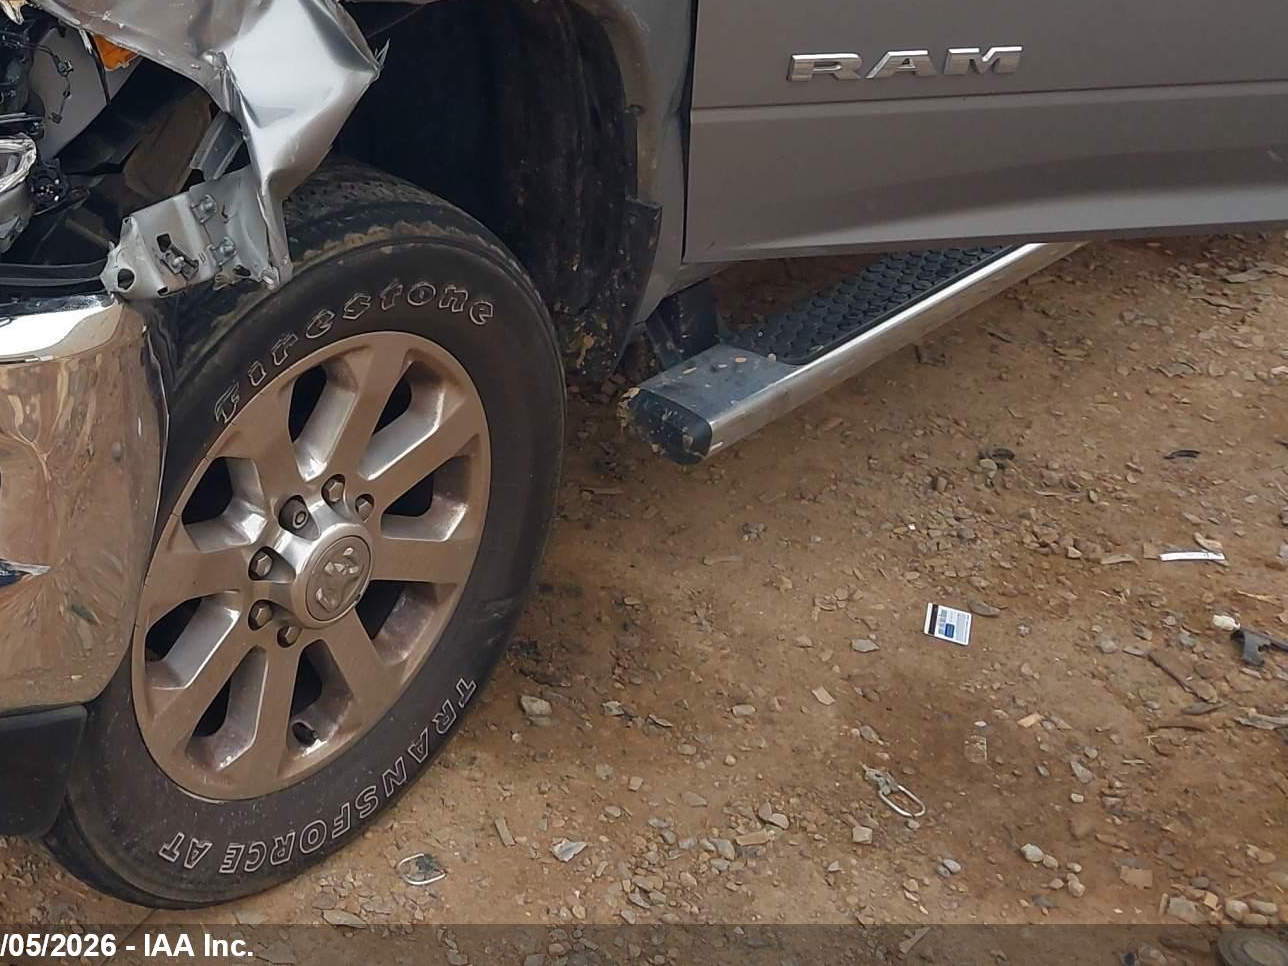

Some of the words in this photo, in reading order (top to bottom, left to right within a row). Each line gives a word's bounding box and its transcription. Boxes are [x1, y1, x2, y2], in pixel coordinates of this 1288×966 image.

[786, 45, 1023, 83] RAM
[213, 278, 496, 425] Firestone
[218, 677, 478, 875] TRANSFORCE
[158, 831, 214, 870] AT
